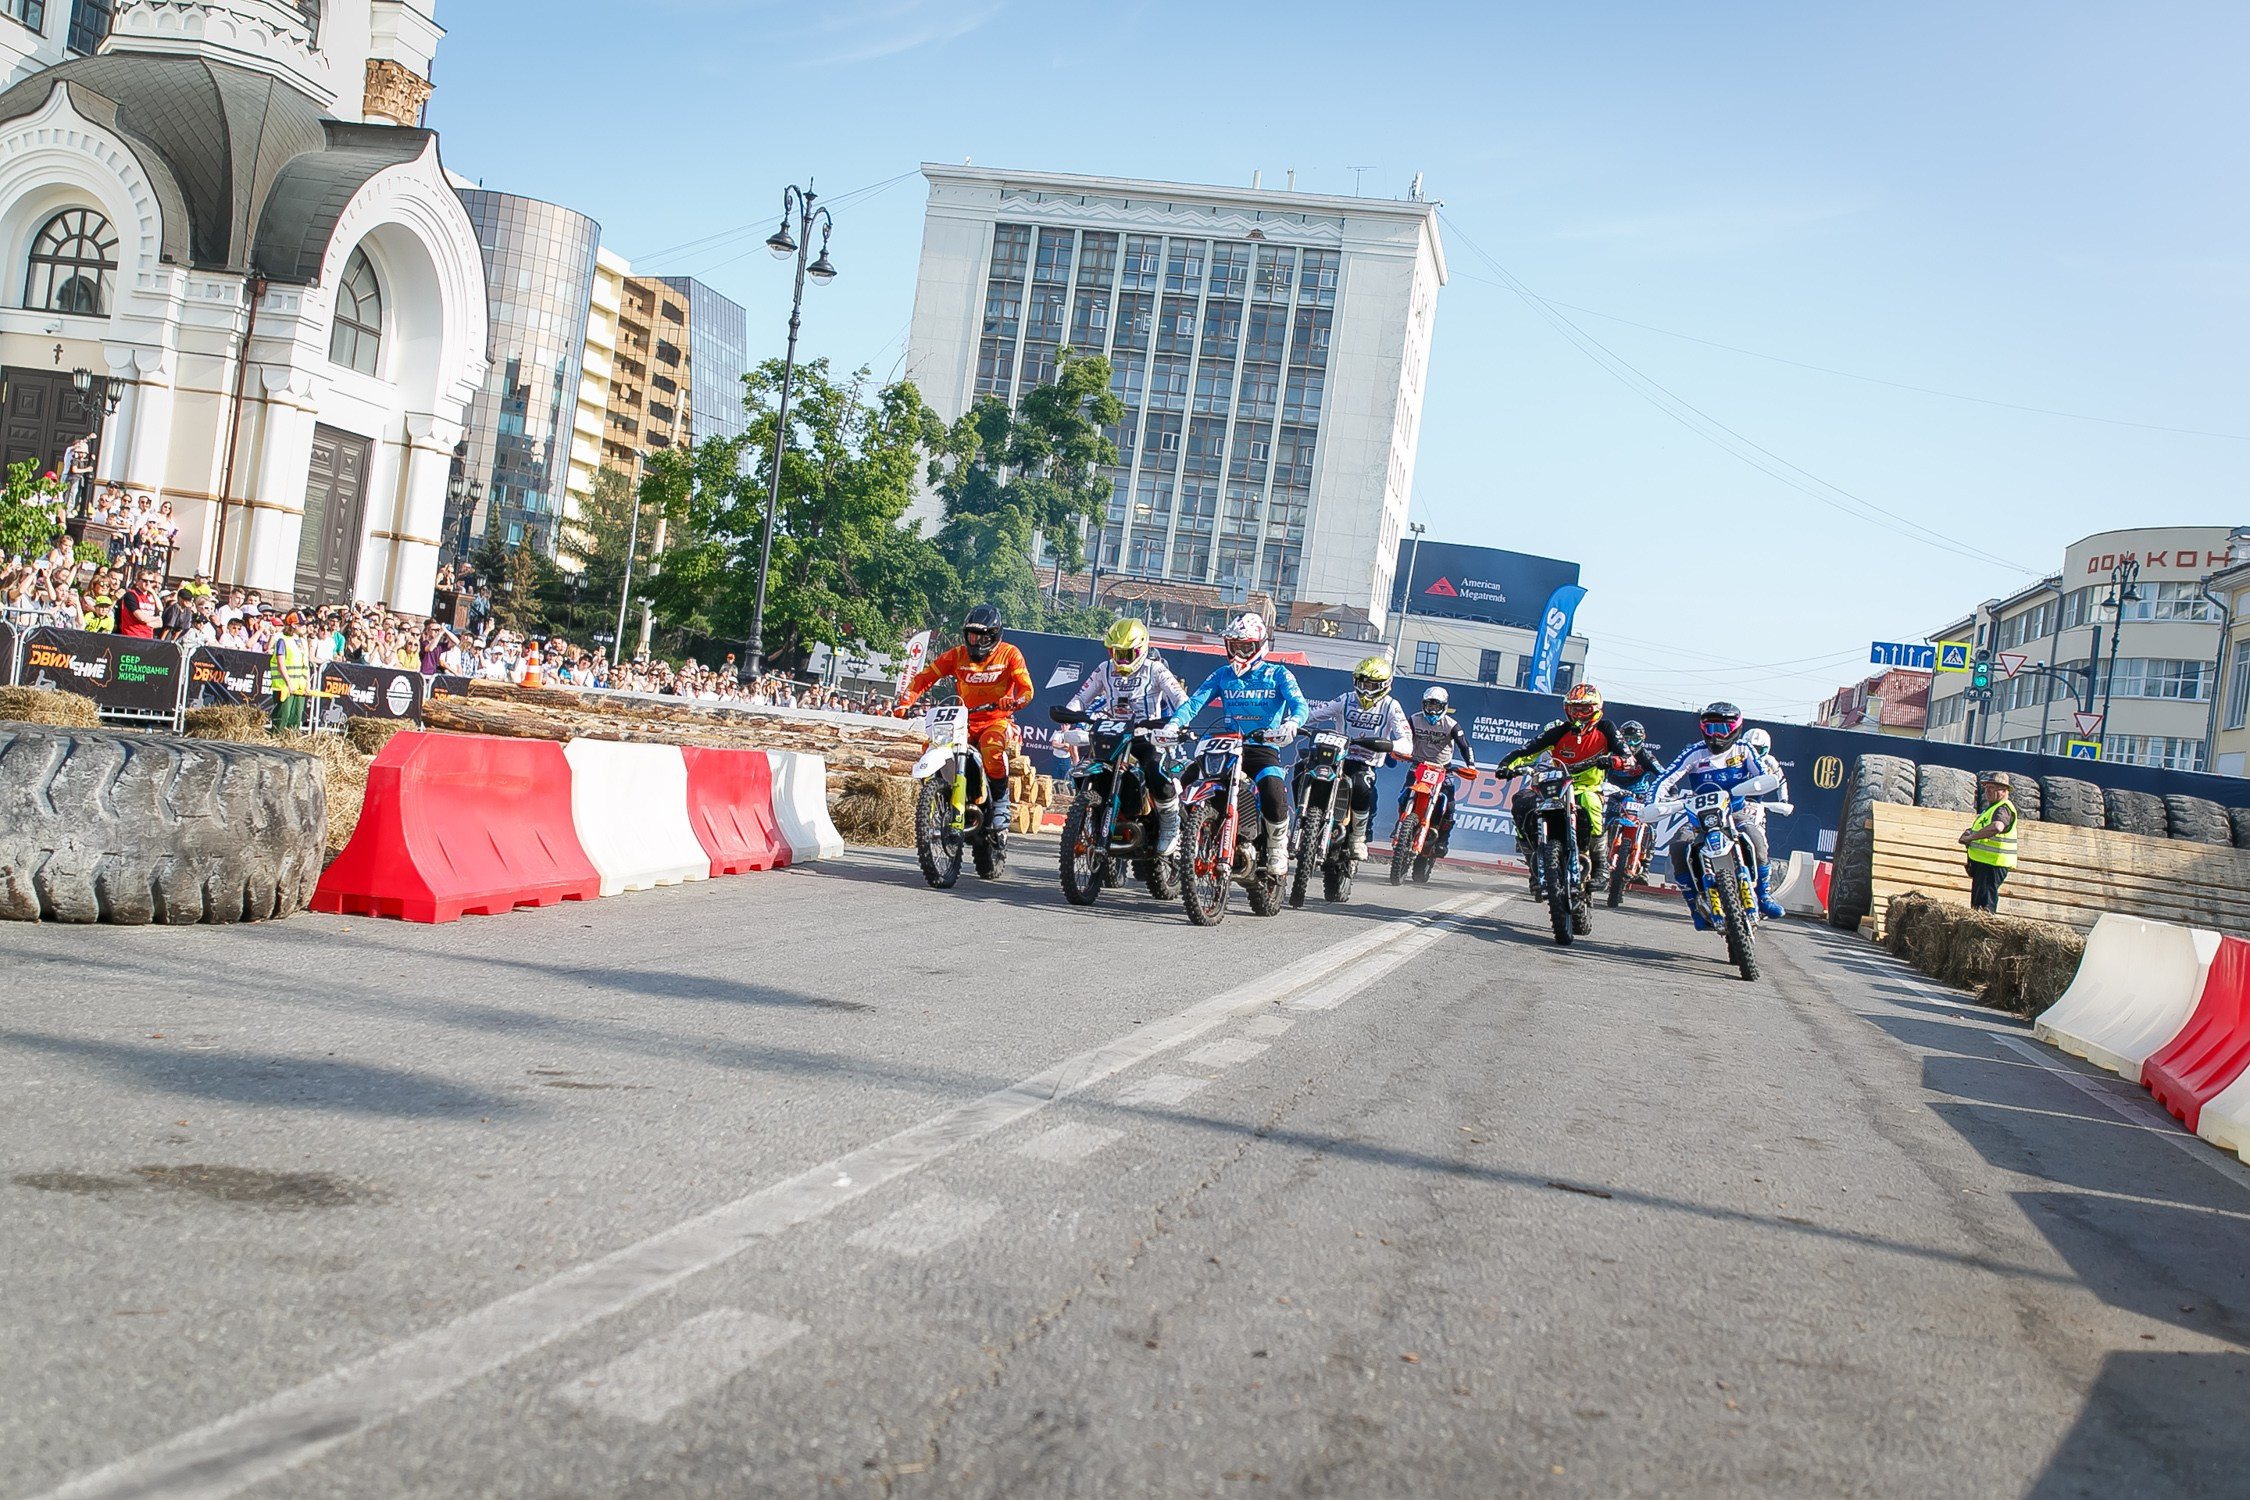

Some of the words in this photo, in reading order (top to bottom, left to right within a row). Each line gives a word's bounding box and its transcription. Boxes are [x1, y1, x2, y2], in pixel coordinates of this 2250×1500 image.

[1460, 577, 1501, 591] American
[1459, 588, 1506, 603] Megatrends
[120, 654, 141, 664] СБЕР
[118, 663, 170, 676] СТРАХОВАНИЕ
[117, 672, 146, 682] ЖИЗНИ
[965, 670, 1003, 684] LEATT
[1224, 689, 1276, 699] AVANTIS
[933, 708, 959, 723] 56
[1097, 720, 1127, 732] 24
[1352, 721, 1375, 729] TEAM
[1472, 724, 1522, 736] КУЛЬТУРЫ
[1473, 716, 1541, 731] ДЕПАРТАМЕНТ
[1205, 739, 1232, 751] 96
[1313, 732, 1348, 748] 888
[1471, 731, 1532, 746] ЕКАТЕРИНБУ
[1423, 771, 1436, 782] 58
[1694, 793, 1719, 810] 89
